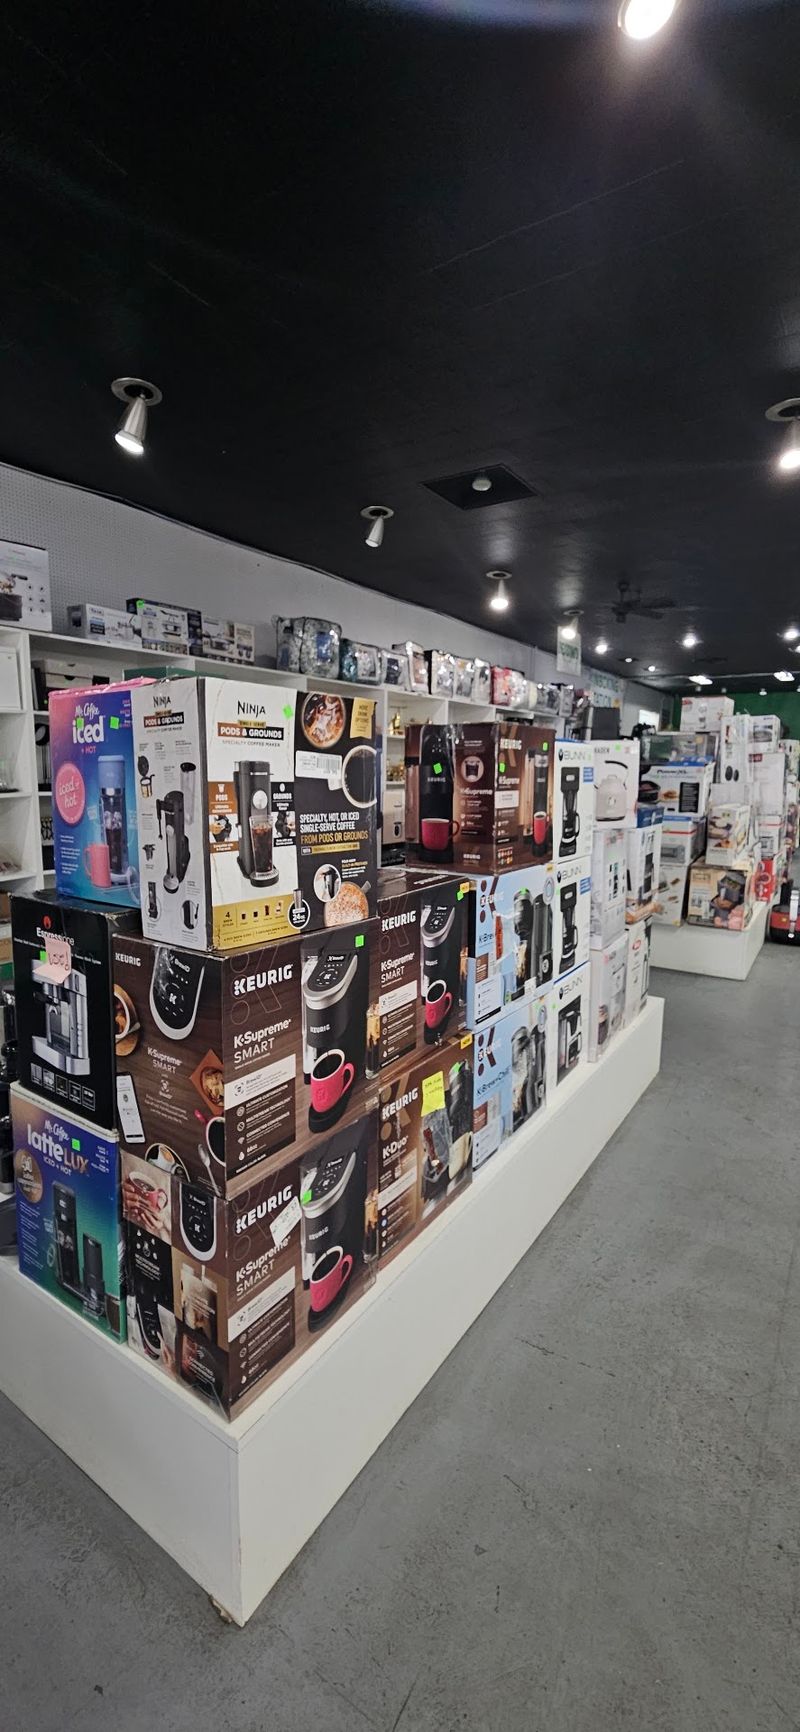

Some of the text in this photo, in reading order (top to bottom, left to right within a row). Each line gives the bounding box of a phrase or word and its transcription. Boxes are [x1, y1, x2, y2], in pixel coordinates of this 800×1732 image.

[84, 703, 100, 720] Coffee
[237, 700, 266, 717] NINJA
[145, 718, 157, 727] PODS
[161, 714, 183, 725] GROUNDS
[73, 716, 104, 743] iced
[220, 727, 240, 735] PODS
[249, 729, 282, 738] GROUNDS
[300, 811, 360, 823] SPECIALTY, HOT, OR ICED
[300, 821, 355, 833] SINGLE-SERVE COFFEE
[301, 833, 317, 844] FROM
[318, 832, 334, 843] PODS
[335, 832, 343, 841] OR
[343, 830, 368, 840] GROUNDS
[381, 910, 416, 932] KEURIG
[115, 952, 141, 967] KEURIG
[234, 964, 293, 996] KEURIG
[381, 965, 405, 983] SMART
[310, 1024, 331, 1033] KEURIG
[234, 1037, 275, 1064] SMART
[152, 1060, 176, 1074] SMART
[382, 1087, 418, 1120] KEURIG
[236, 1185, 292, 1234] KEURIG
[309, 1226, 329, 1240] KEURIG
[236, 1259, 275, 1297] SMART
